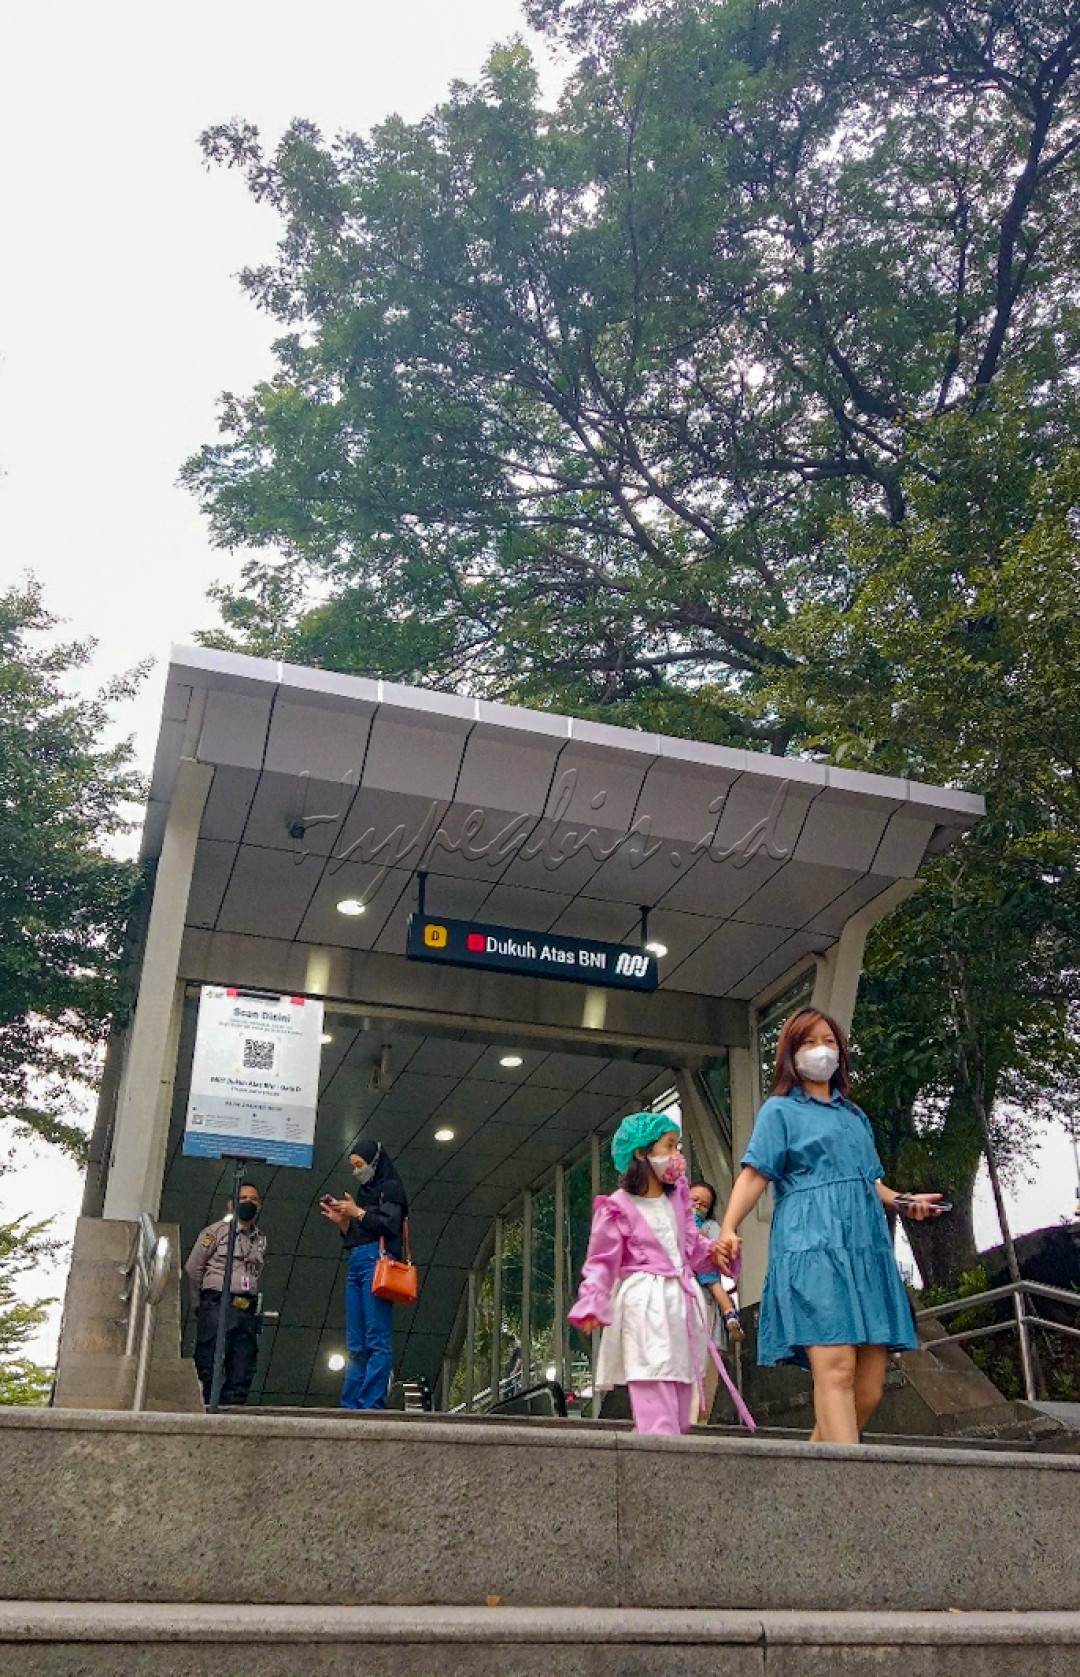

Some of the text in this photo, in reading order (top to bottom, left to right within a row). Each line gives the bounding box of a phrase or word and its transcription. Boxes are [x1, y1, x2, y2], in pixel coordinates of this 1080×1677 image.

[486, 936, 606, 969] Dukuh Atas BNI
[233, 1007, 291, 1023] Scan Disini
